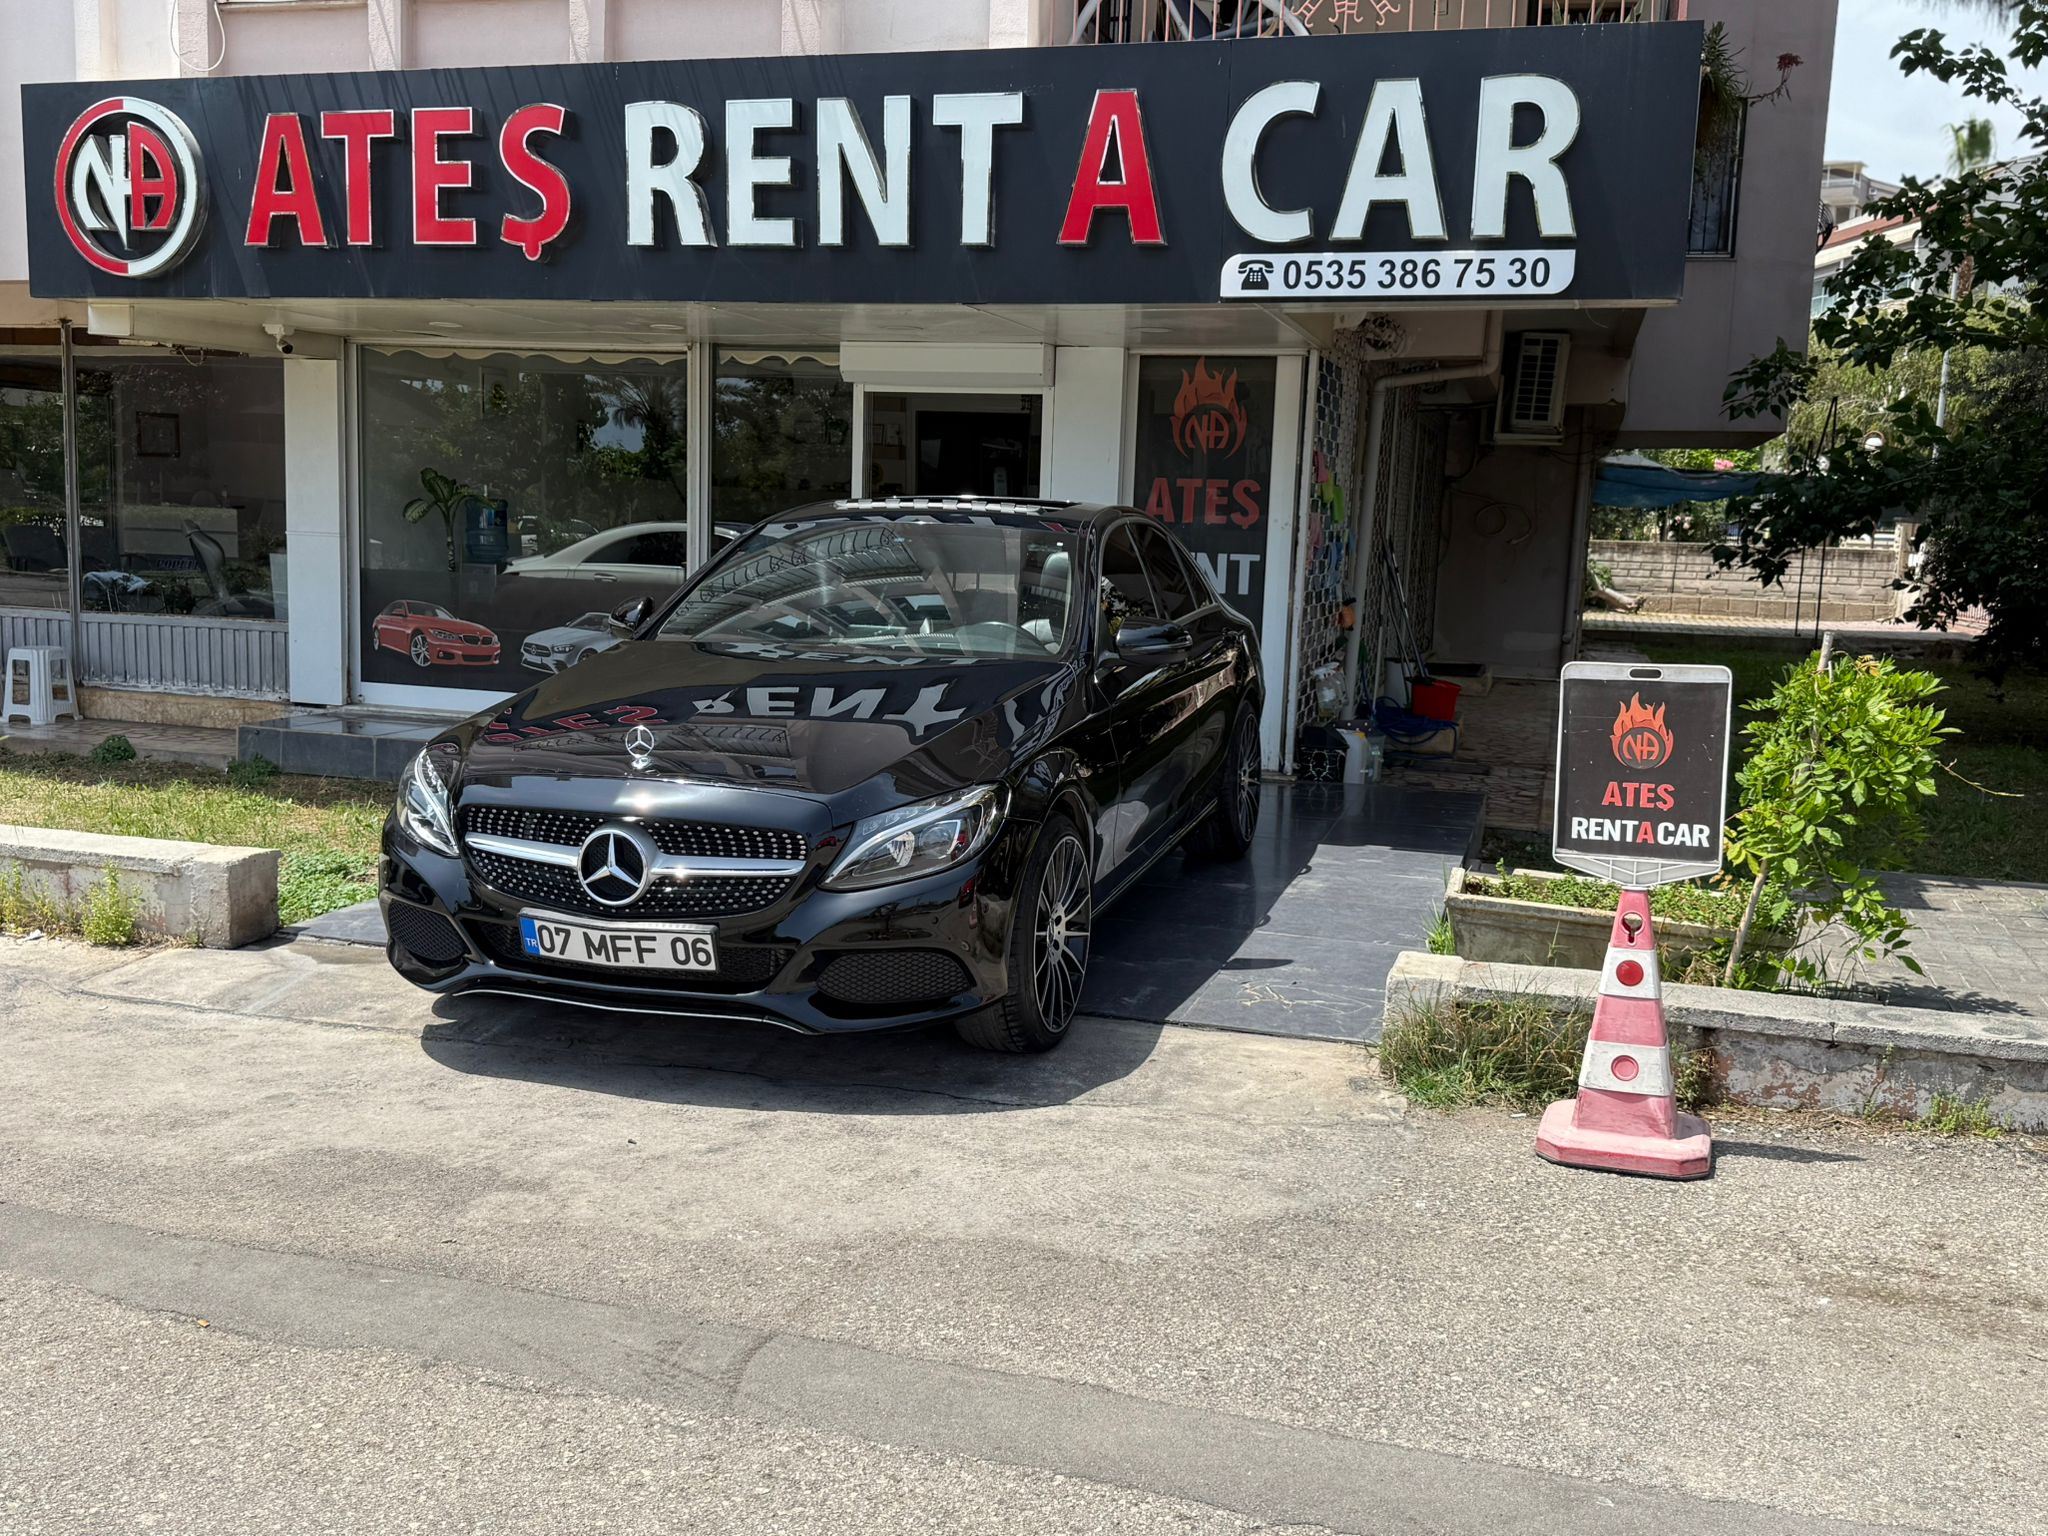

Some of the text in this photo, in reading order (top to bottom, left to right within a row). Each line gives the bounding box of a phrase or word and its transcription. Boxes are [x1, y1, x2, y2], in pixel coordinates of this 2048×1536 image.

[244, 72, 1582, 261] ATEŞ RENT A CAR
[1282, 257, 1551, 290] 0535 386 75 30
[1145, 477, 1262, 530] ATEŞ
[1601, 781, 1676, 811] ATEŞ
[526, 924, 712, 967] TR 07 MFF 06
